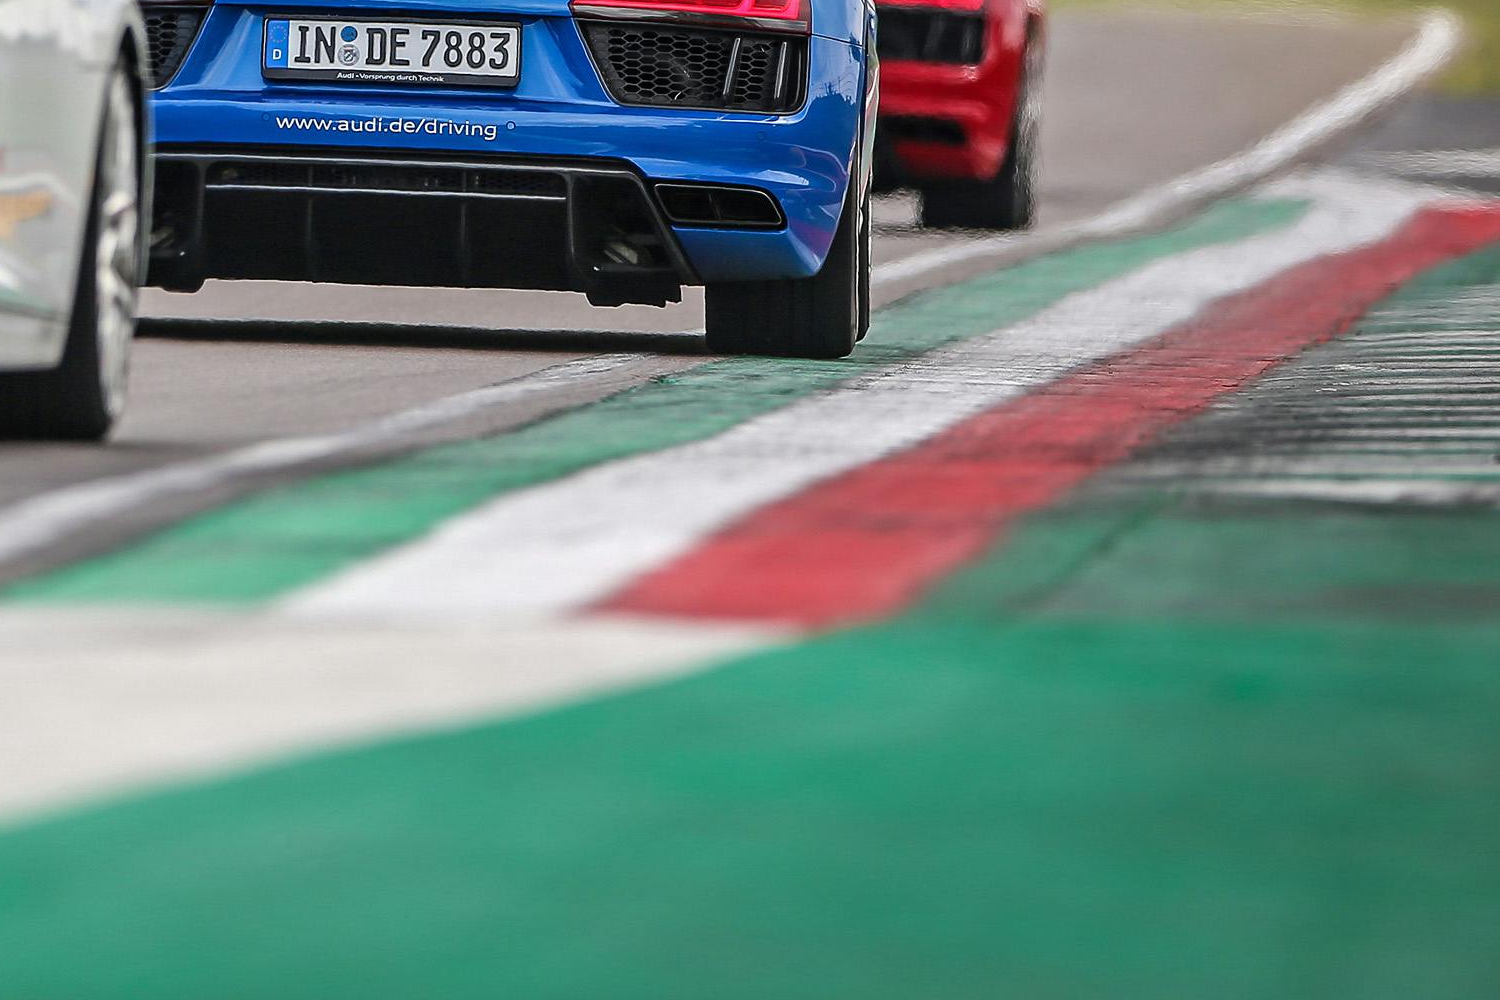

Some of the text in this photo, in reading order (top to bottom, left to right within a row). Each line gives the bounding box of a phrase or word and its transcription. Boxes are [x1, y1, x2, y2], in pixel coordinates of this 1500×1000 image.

[272, 48, 282, 60] D
[294, 25, 511, 70] IN DE 7883
[360, 73, 395, 81] Vorsprung
[396, 74, 417, 82] durch
[276, 116, 497, 140] www.audi.de/driving
